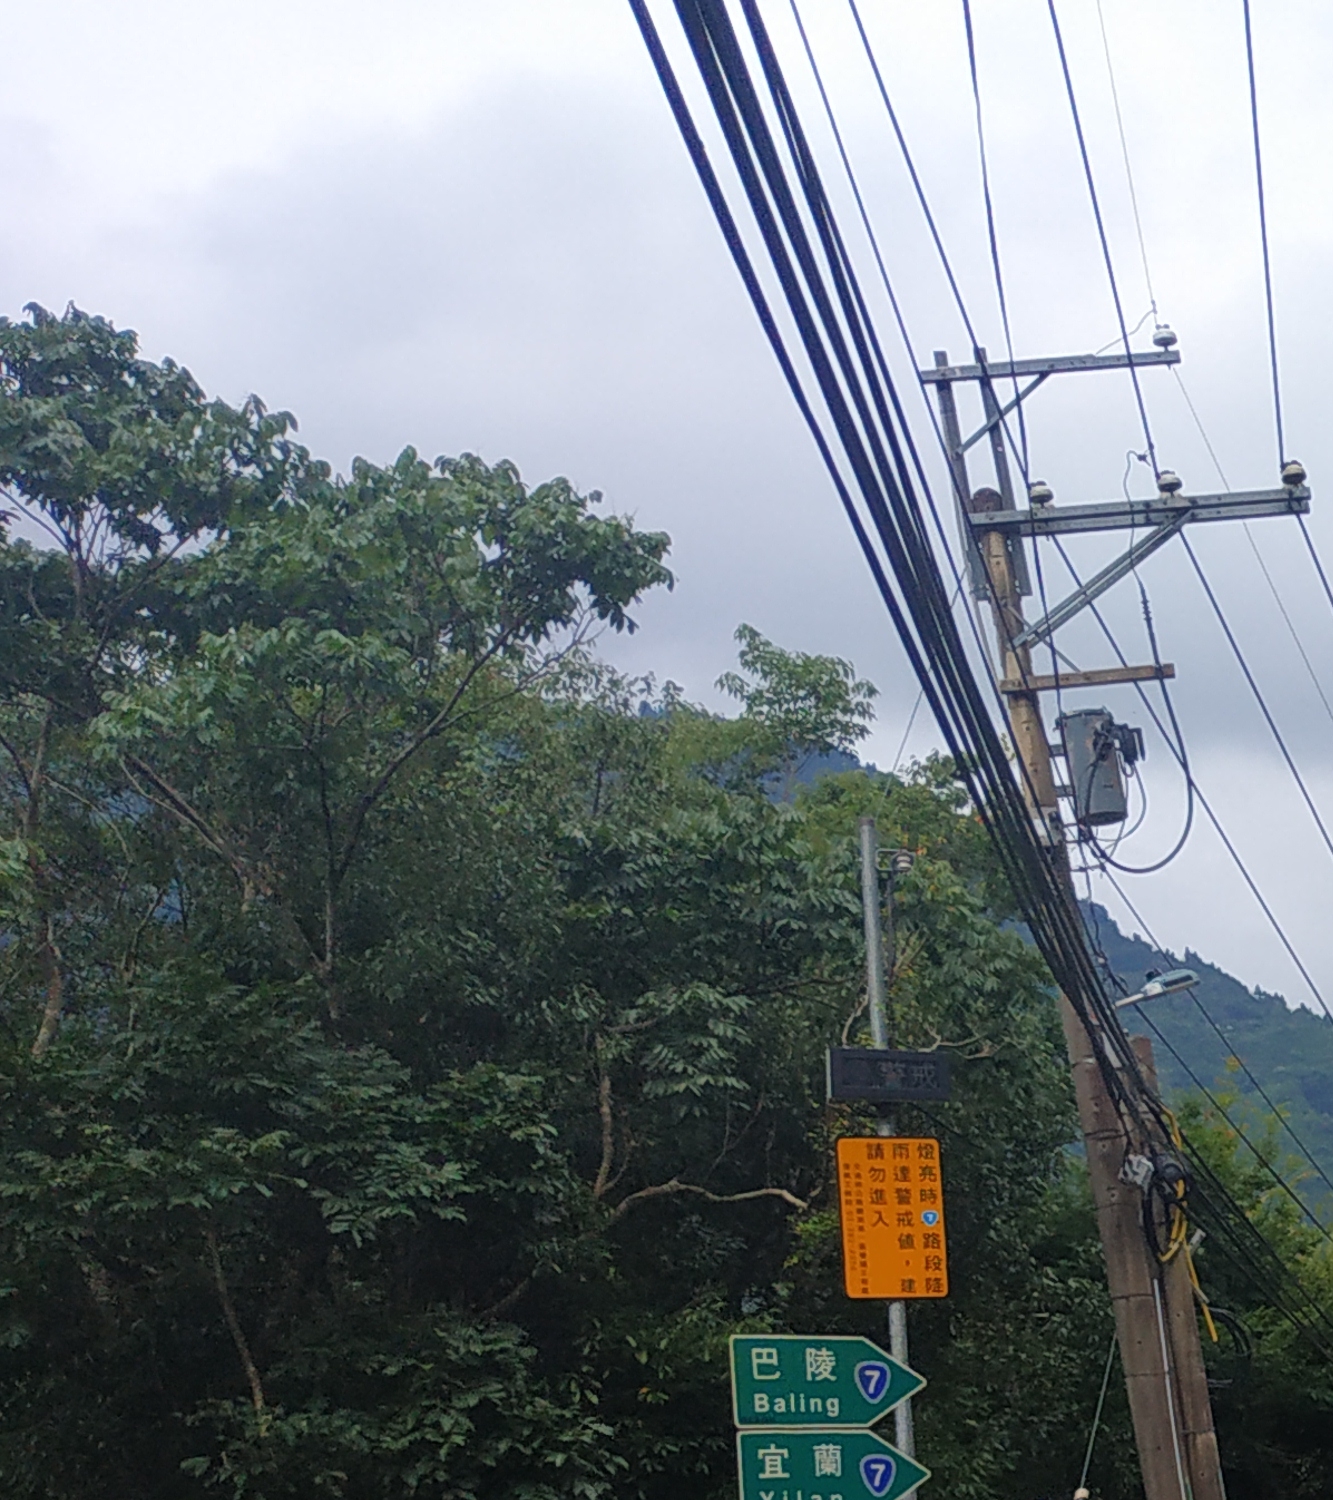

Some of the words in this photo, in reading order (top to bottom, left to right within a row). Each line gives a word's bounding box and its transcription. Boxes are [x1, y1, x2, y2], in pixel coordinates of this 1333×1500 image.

[866, 1142, 890, 1229] 請勿進入
[750, 1347, 838, 1382] 巴陵
[863, 1369, 882, 1395] 7
[753, 1392, 841, 1418] Baling
[757, 1443, 843, 1480] 宜蘭
[869, 1463, 887, 1488] 7
